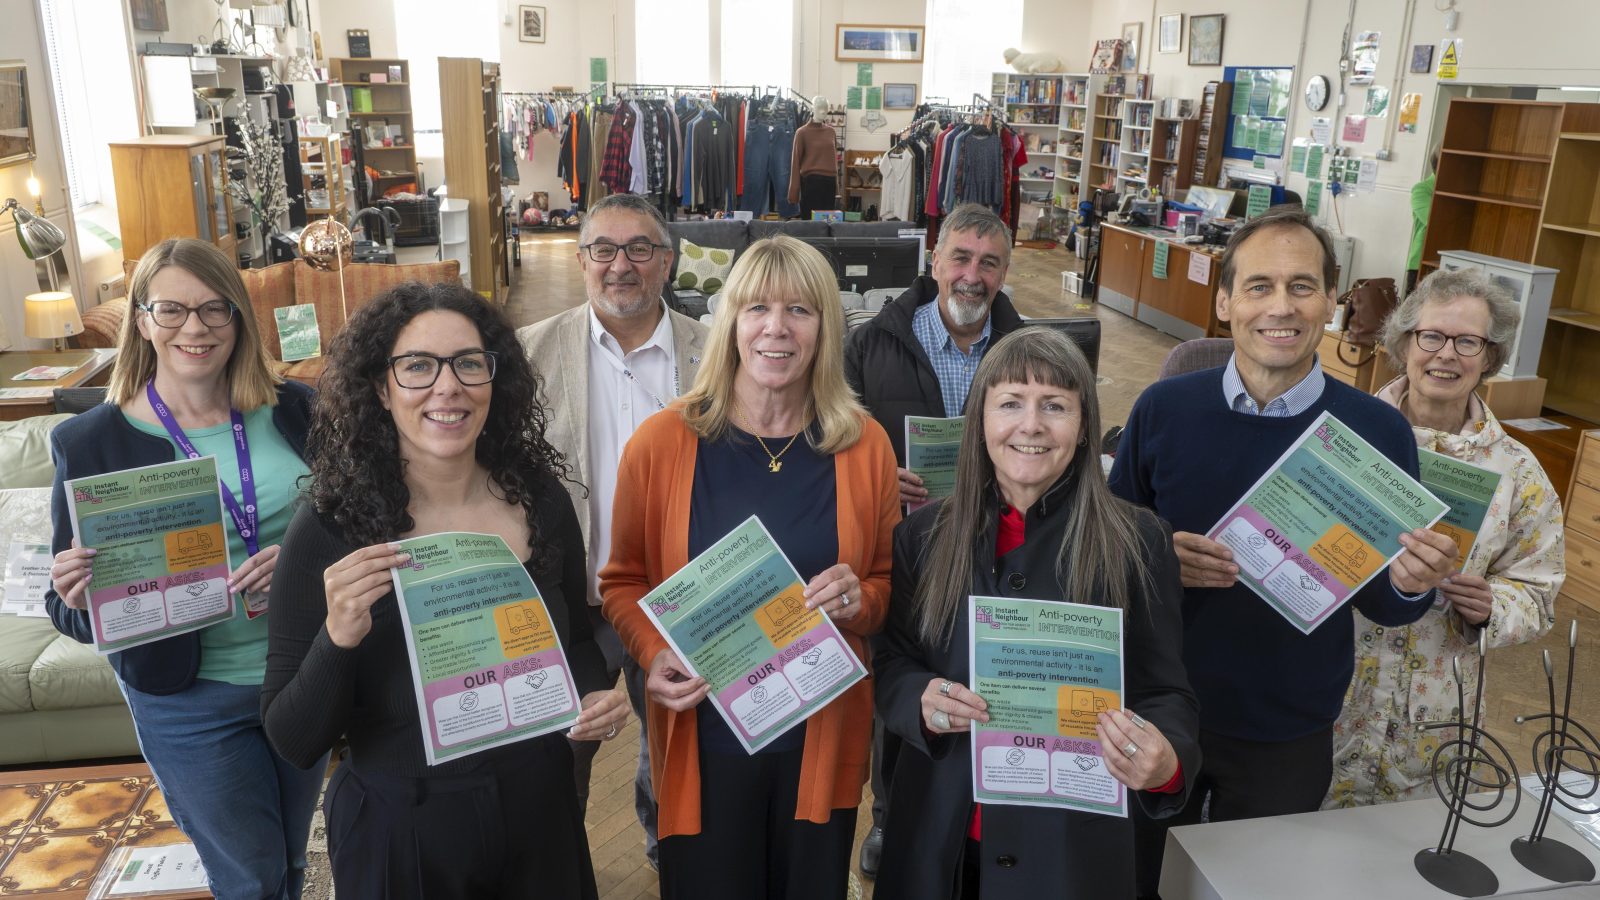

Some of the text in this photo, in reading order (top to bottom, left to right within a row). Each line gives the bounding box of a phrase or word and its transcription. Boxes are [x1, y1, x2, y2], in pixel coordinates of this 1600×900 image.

[1333, 439, 1361, 462] Neighbour
[1338, 435, 1358, 452] Instant
[140, 468, 200, 483] Anti-poverty
[1432, 460, 1485, 483] Anti-poverty
[95, 486, 129, 495] Neighbour
[1301, 468, 1343, 502] environmental
[1342, 501, 1363, 519] activity
[1316, 465, 1389, 526] For us, reuse isn't just an
[1371, 463, 1425, 507] Anti-poverty
[1298, 479, 1336, 511] anti-poverty
[1337, 511, 1376, 542] intervention
[1361, 472, 1430, 527] INTERVENTION
[98, 518, 150, 532] environmental
[152, 514, 176, 523] activity
[106, 519, 202, 540] anti-poverty intervention
[414, 544, 438, 553] Instant
[456, 536, 498, 548] Anti-poverty
[415, 550, 448, 560] Neighbour
[700, 534, 749, 573] Anti-poverty
[1265, 529, 1291, 552] OUR
[1291, 554, 1327, 584] ASKS:
[128, 581, 159, 596] OUR
[166, 572, 204, 588] ASKS:
[458, 578, 477, 586] reuse
[479, 573, 492, 582] isn't
[665, 581, 684, 597] Instant
[424, 589, 475, 607] environmental
[477, 585, 498, 595] activity
[668, 581, 695, 602] Neighbour
[691, 614, 703, 624] For
[713, 594, 730, 608] reuse
[731, 584, 744, 596] isn't
[744, 576, 755, 588] just
[755, 570, 764, 578] an
[434, 593, 522, 618] anti-poverty intervention
[690, 607, 731, 637] environmental
[732, 591, 753, 608] activity
[702, 614, 740, 642] anti-poverty
[740, 586, 779, 614] intervention
[1039, 609, 1102, 626] Anti-poverty
[1040, 623, 1120, 642] INTERVENTION
[464, 658, 542, 688] OUR ASKS:
[748, 663, 775, 685] OUR
[778, 639, 814, 666] ASKS:
[992, 658, 1044, 667] environmental
[1046, 662, 1072, 671] activity
[998, 671, 1099, 684] anti-poverty intervention
[1014, 736, 1096, 755] OUR ASKS:
